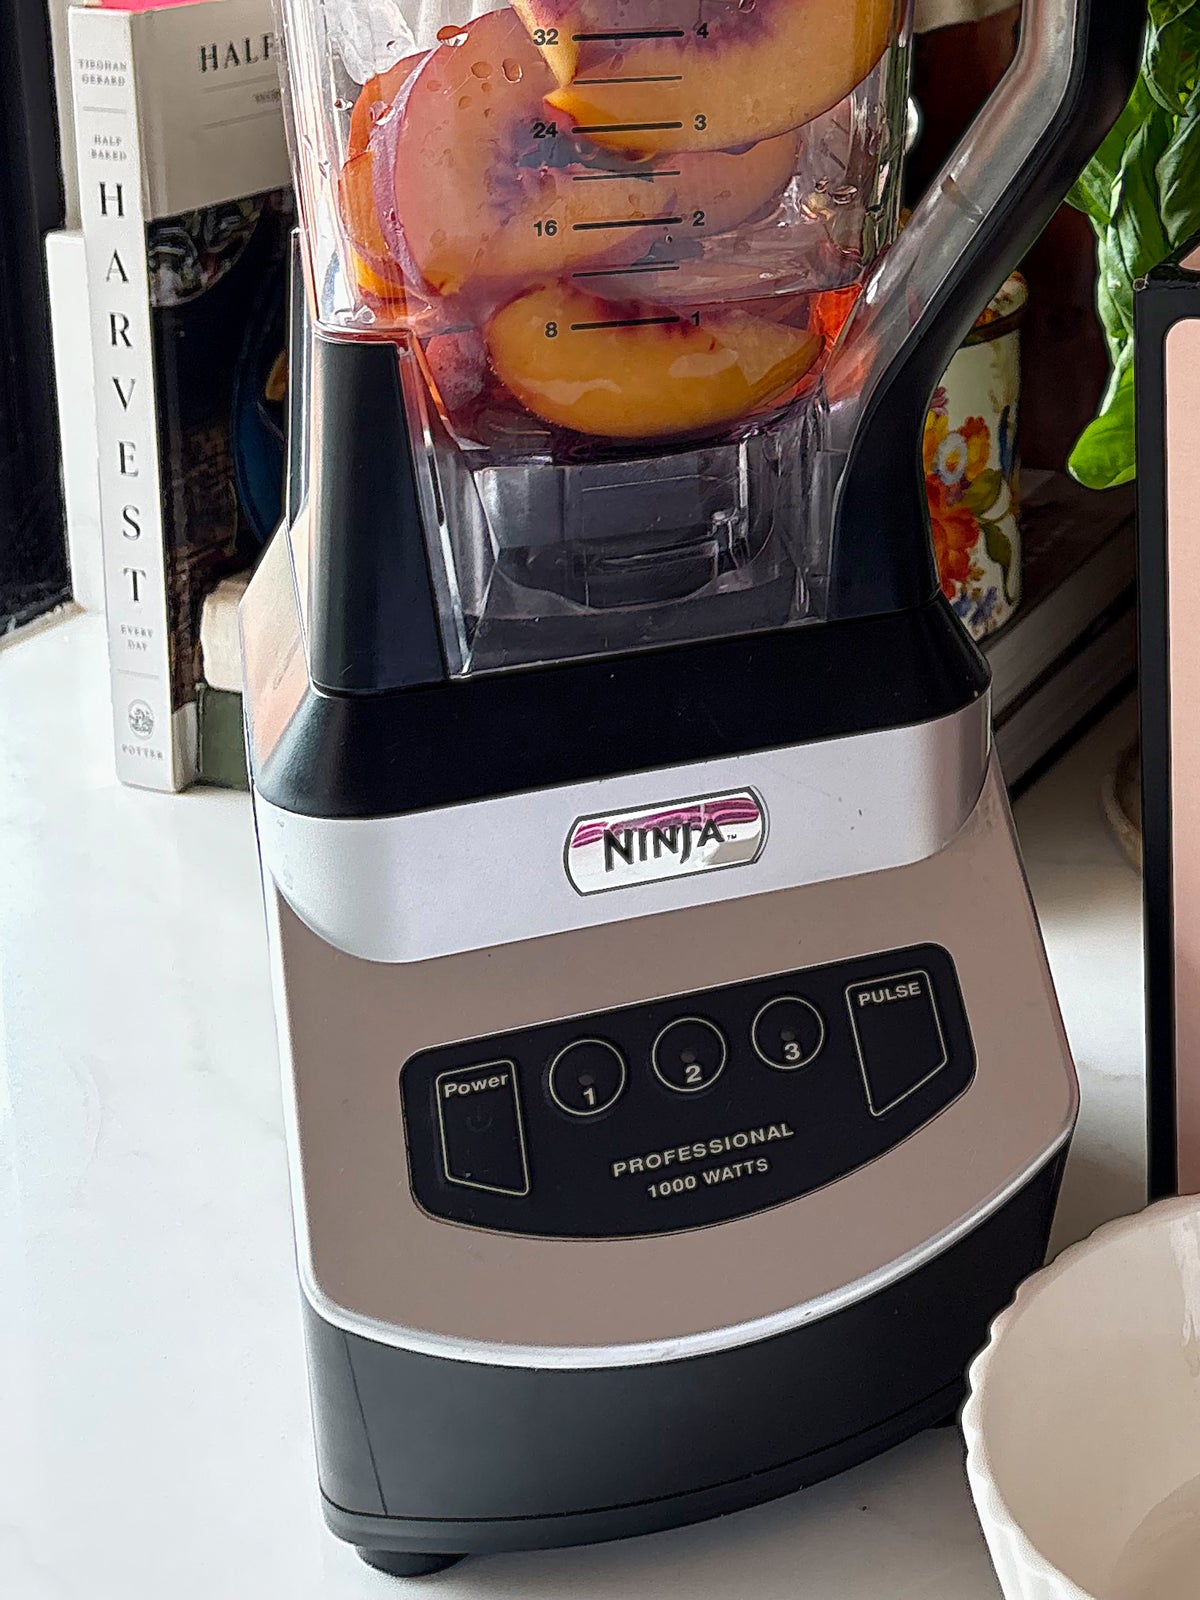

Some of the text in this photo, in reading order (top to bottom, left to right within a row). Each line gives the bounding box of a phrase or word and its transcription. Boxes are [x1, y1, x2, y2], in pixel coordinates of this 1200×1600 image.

[533, 29, 559, 46] 32
[696, 23, 710, 40] 4
[199, 32, 275, 74] HALF
[533, 122, 558, 139] 24
[694, 114, 707, 131] 3
[94, 134, 122, 147] HALF
[90, 148, 127, 161] BAKED
[692, 211, 706, 227] 2
[533, 220, 558, 237] 16
[691, 311, 701, 327] 1
[544, 321, 558, 338] 8
[99, 181, 148, 602] HARVEST
[603, 818, 725, 872] NINJA
[857, 981, 922, 1007] PULSE
[784, 1042, 801, 1061] 3
[684, 1065, 702, 1084] 2
[443, 1072, 509, 1098] Power
[583, 1088, 596, 1106] 1
[612, 1122, 795, 1178] PROFESSIONAL
[647, 1157, 769, 1199] 1000 WATTS
